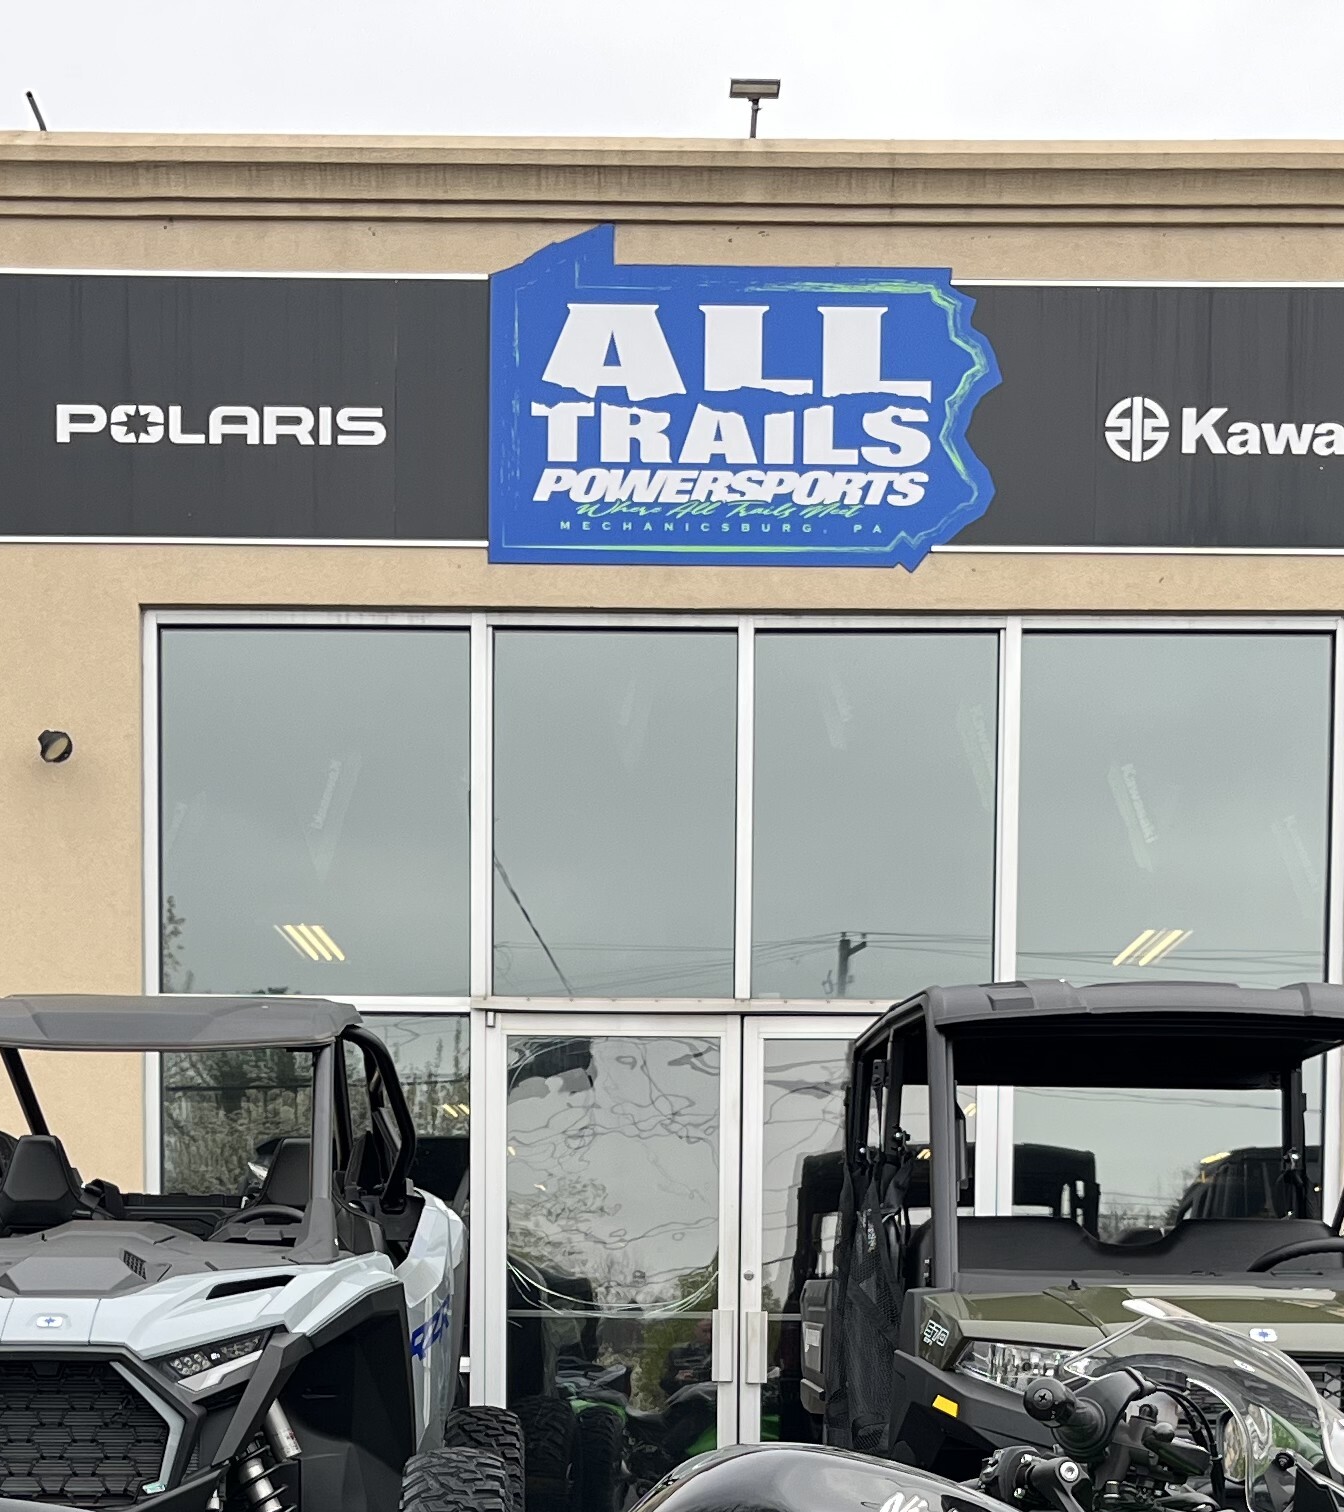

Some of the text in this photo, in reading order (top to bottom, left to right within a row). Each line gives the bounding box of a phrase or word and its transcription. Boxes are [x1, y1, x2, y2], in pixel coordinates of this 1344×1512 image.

[541, 303, 932, 404] ALL
[56, 403, 387, 446] POLARIS
[531, 402, 931, 467] TRAILS
[532, 468, 929, 506] POWERSPORTS
[576, 499, 864, 518] Where All Trails Meet
[853, 524, 883, 534] PA
